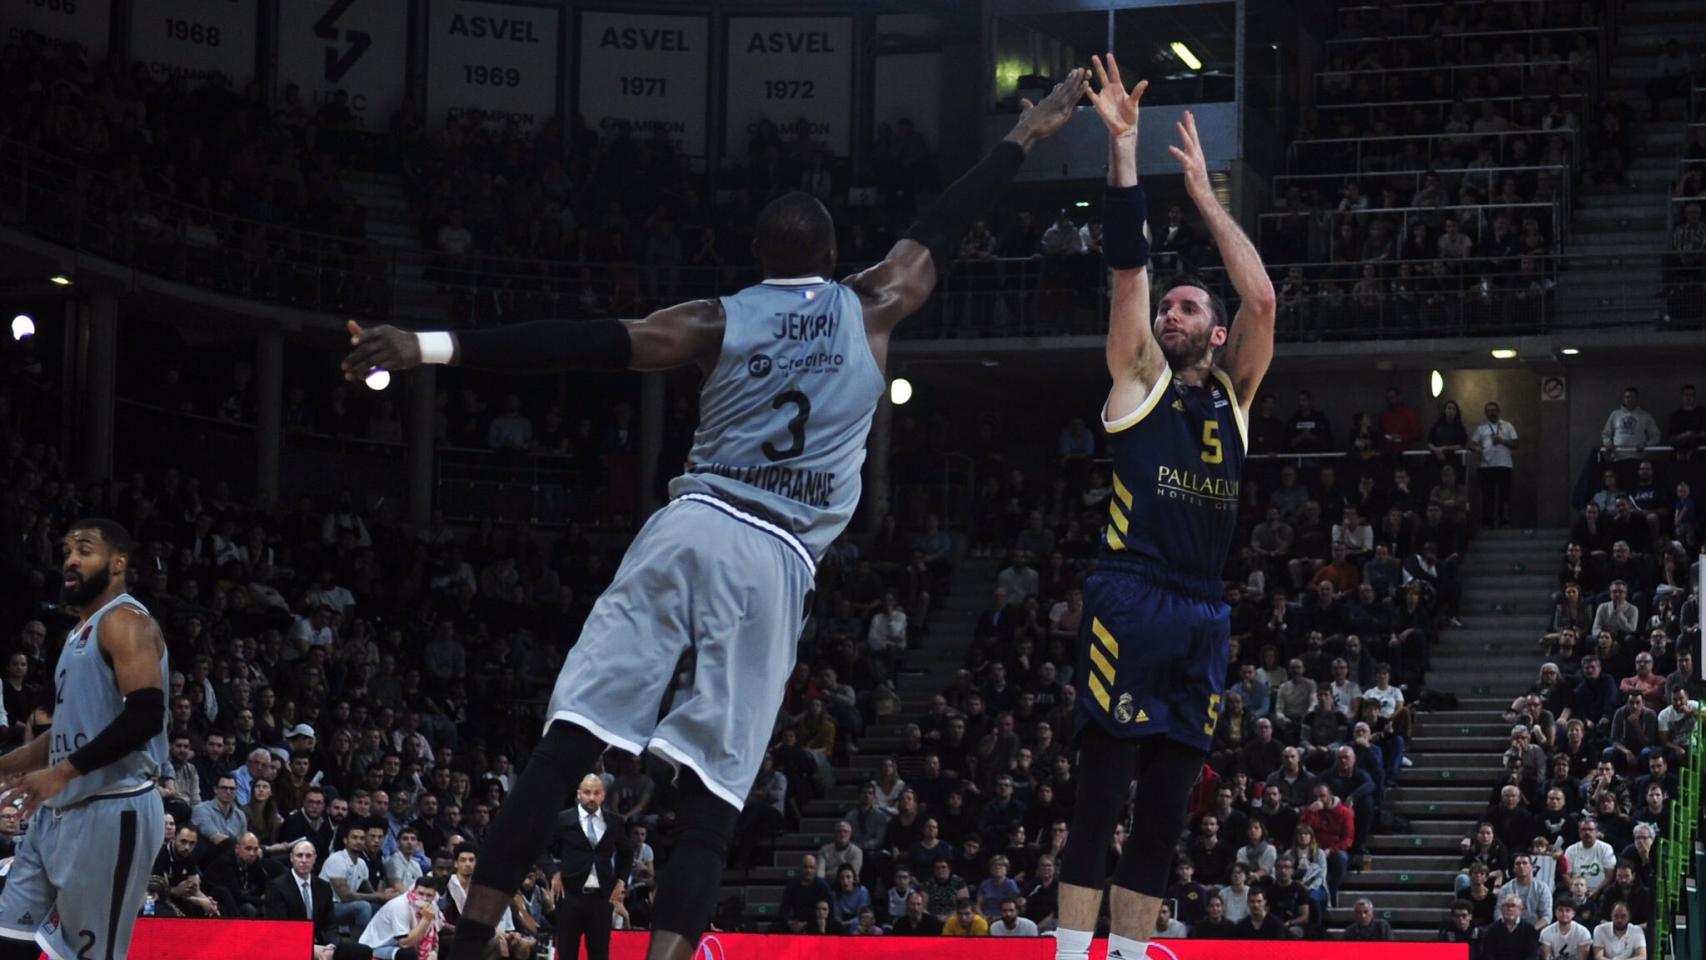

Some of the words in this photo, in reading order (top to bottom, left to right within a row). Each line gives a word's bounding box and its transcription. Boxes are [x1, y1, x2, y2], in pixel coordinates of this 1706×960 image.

[165, 17, 220, 47] 1968
[449, 14, 539, 43] ASVEL
[600, 26, 689, 52] ASVEL
[747, 31, 834, 54] ASVEL
[463, 64, 520, 88] 1969
[621, 76, 666, 97] 1971
[764, 80, 815, 100] 1972
[447, 107, 535, 126] CHMPION
[762, 390, 811, 462] 3
[1201, 419, 1224, 465] 5
[1204, 692, 1221, 736] 5
[77, 929, 96, 960] 2
